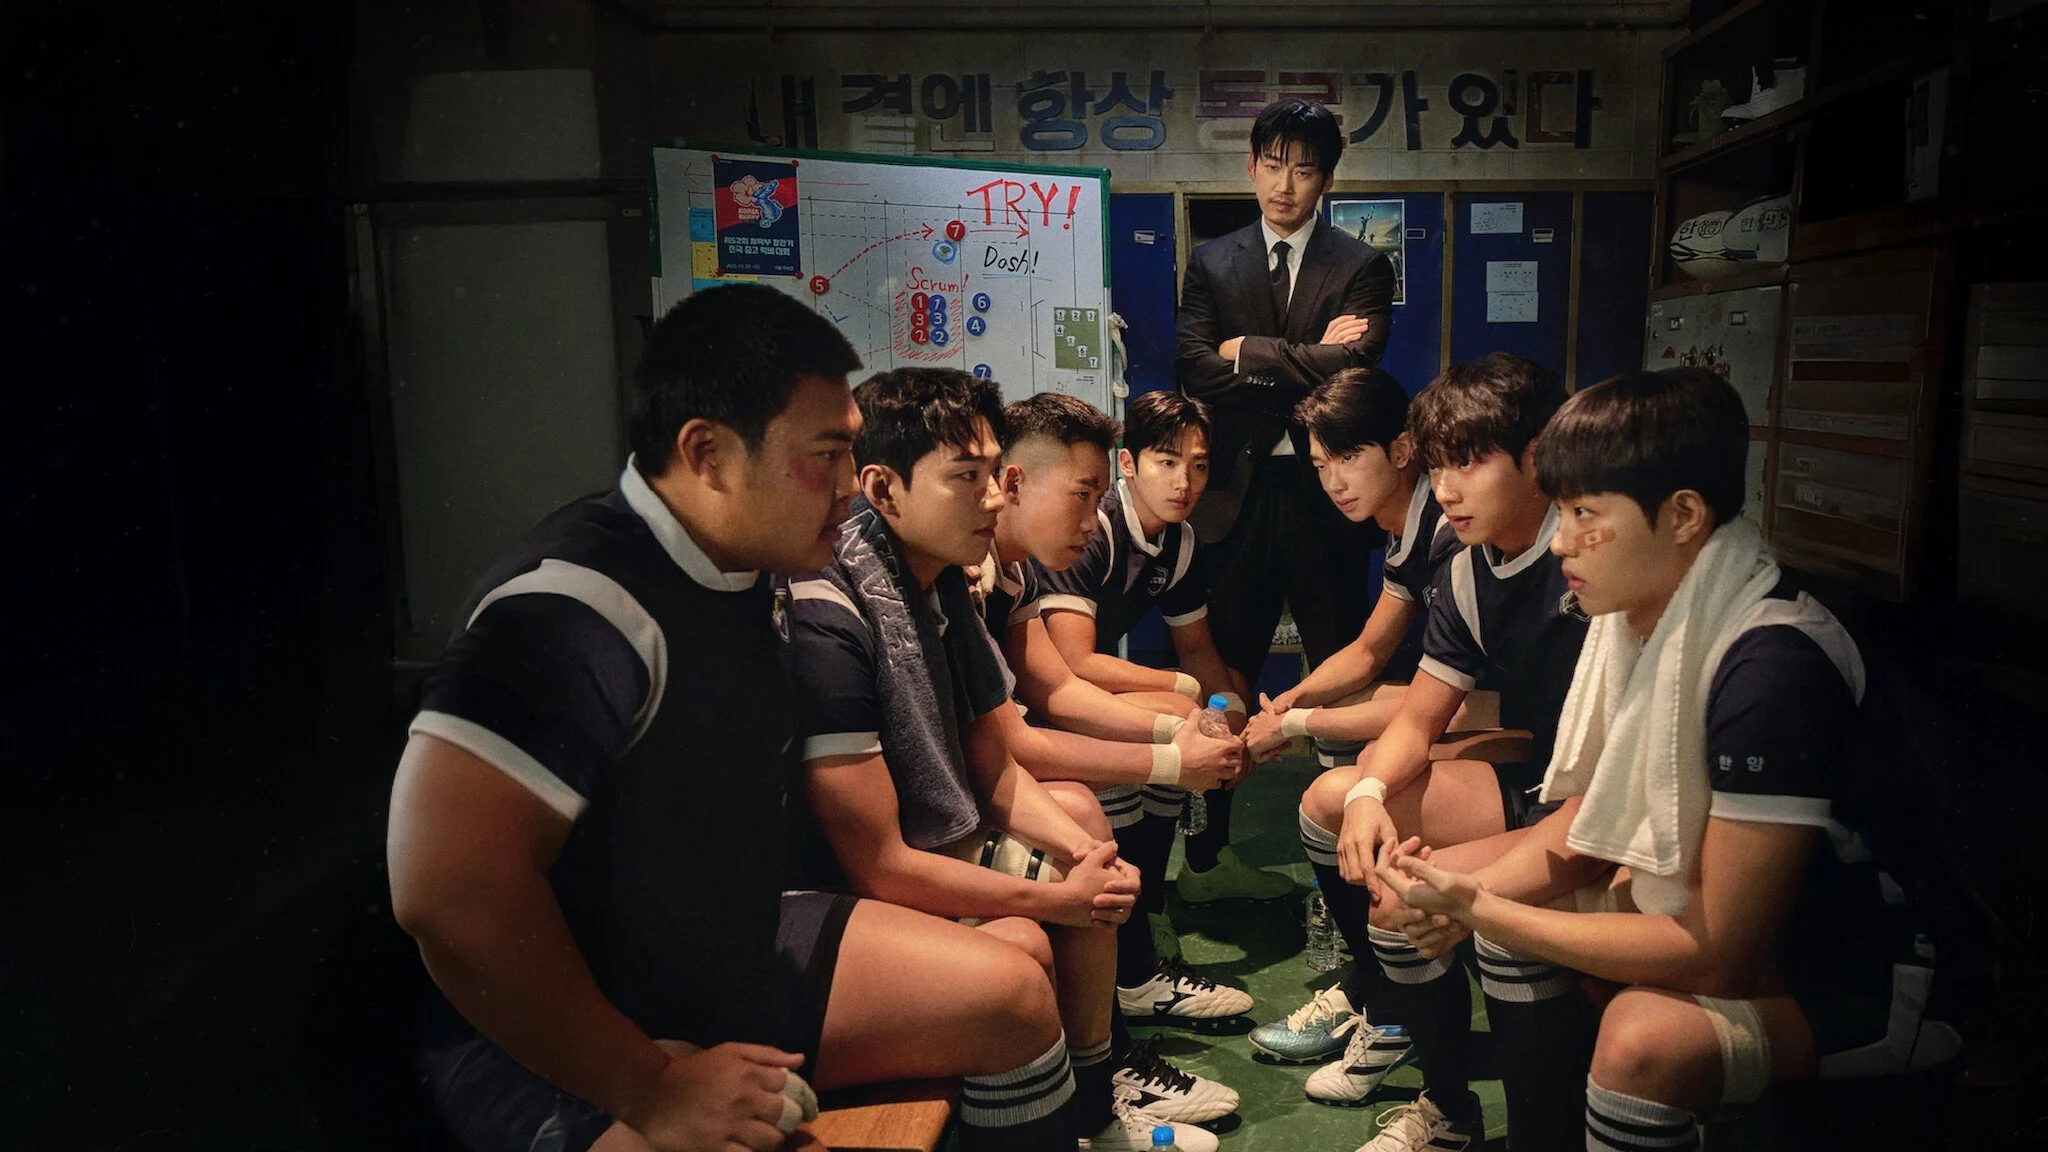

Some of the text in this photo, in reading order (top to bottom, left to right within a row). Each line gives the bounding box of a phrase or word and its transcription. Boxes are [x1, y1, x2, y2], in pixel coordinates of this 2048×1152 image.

[744, 73, 818, 150] 내
[1016, 69, 1174, 150] 항상
[1448, 69, 1600, 150] 있다
[966, 178, 1082, 230] TRY!
[906, 265, 969, 293] Scrum!
